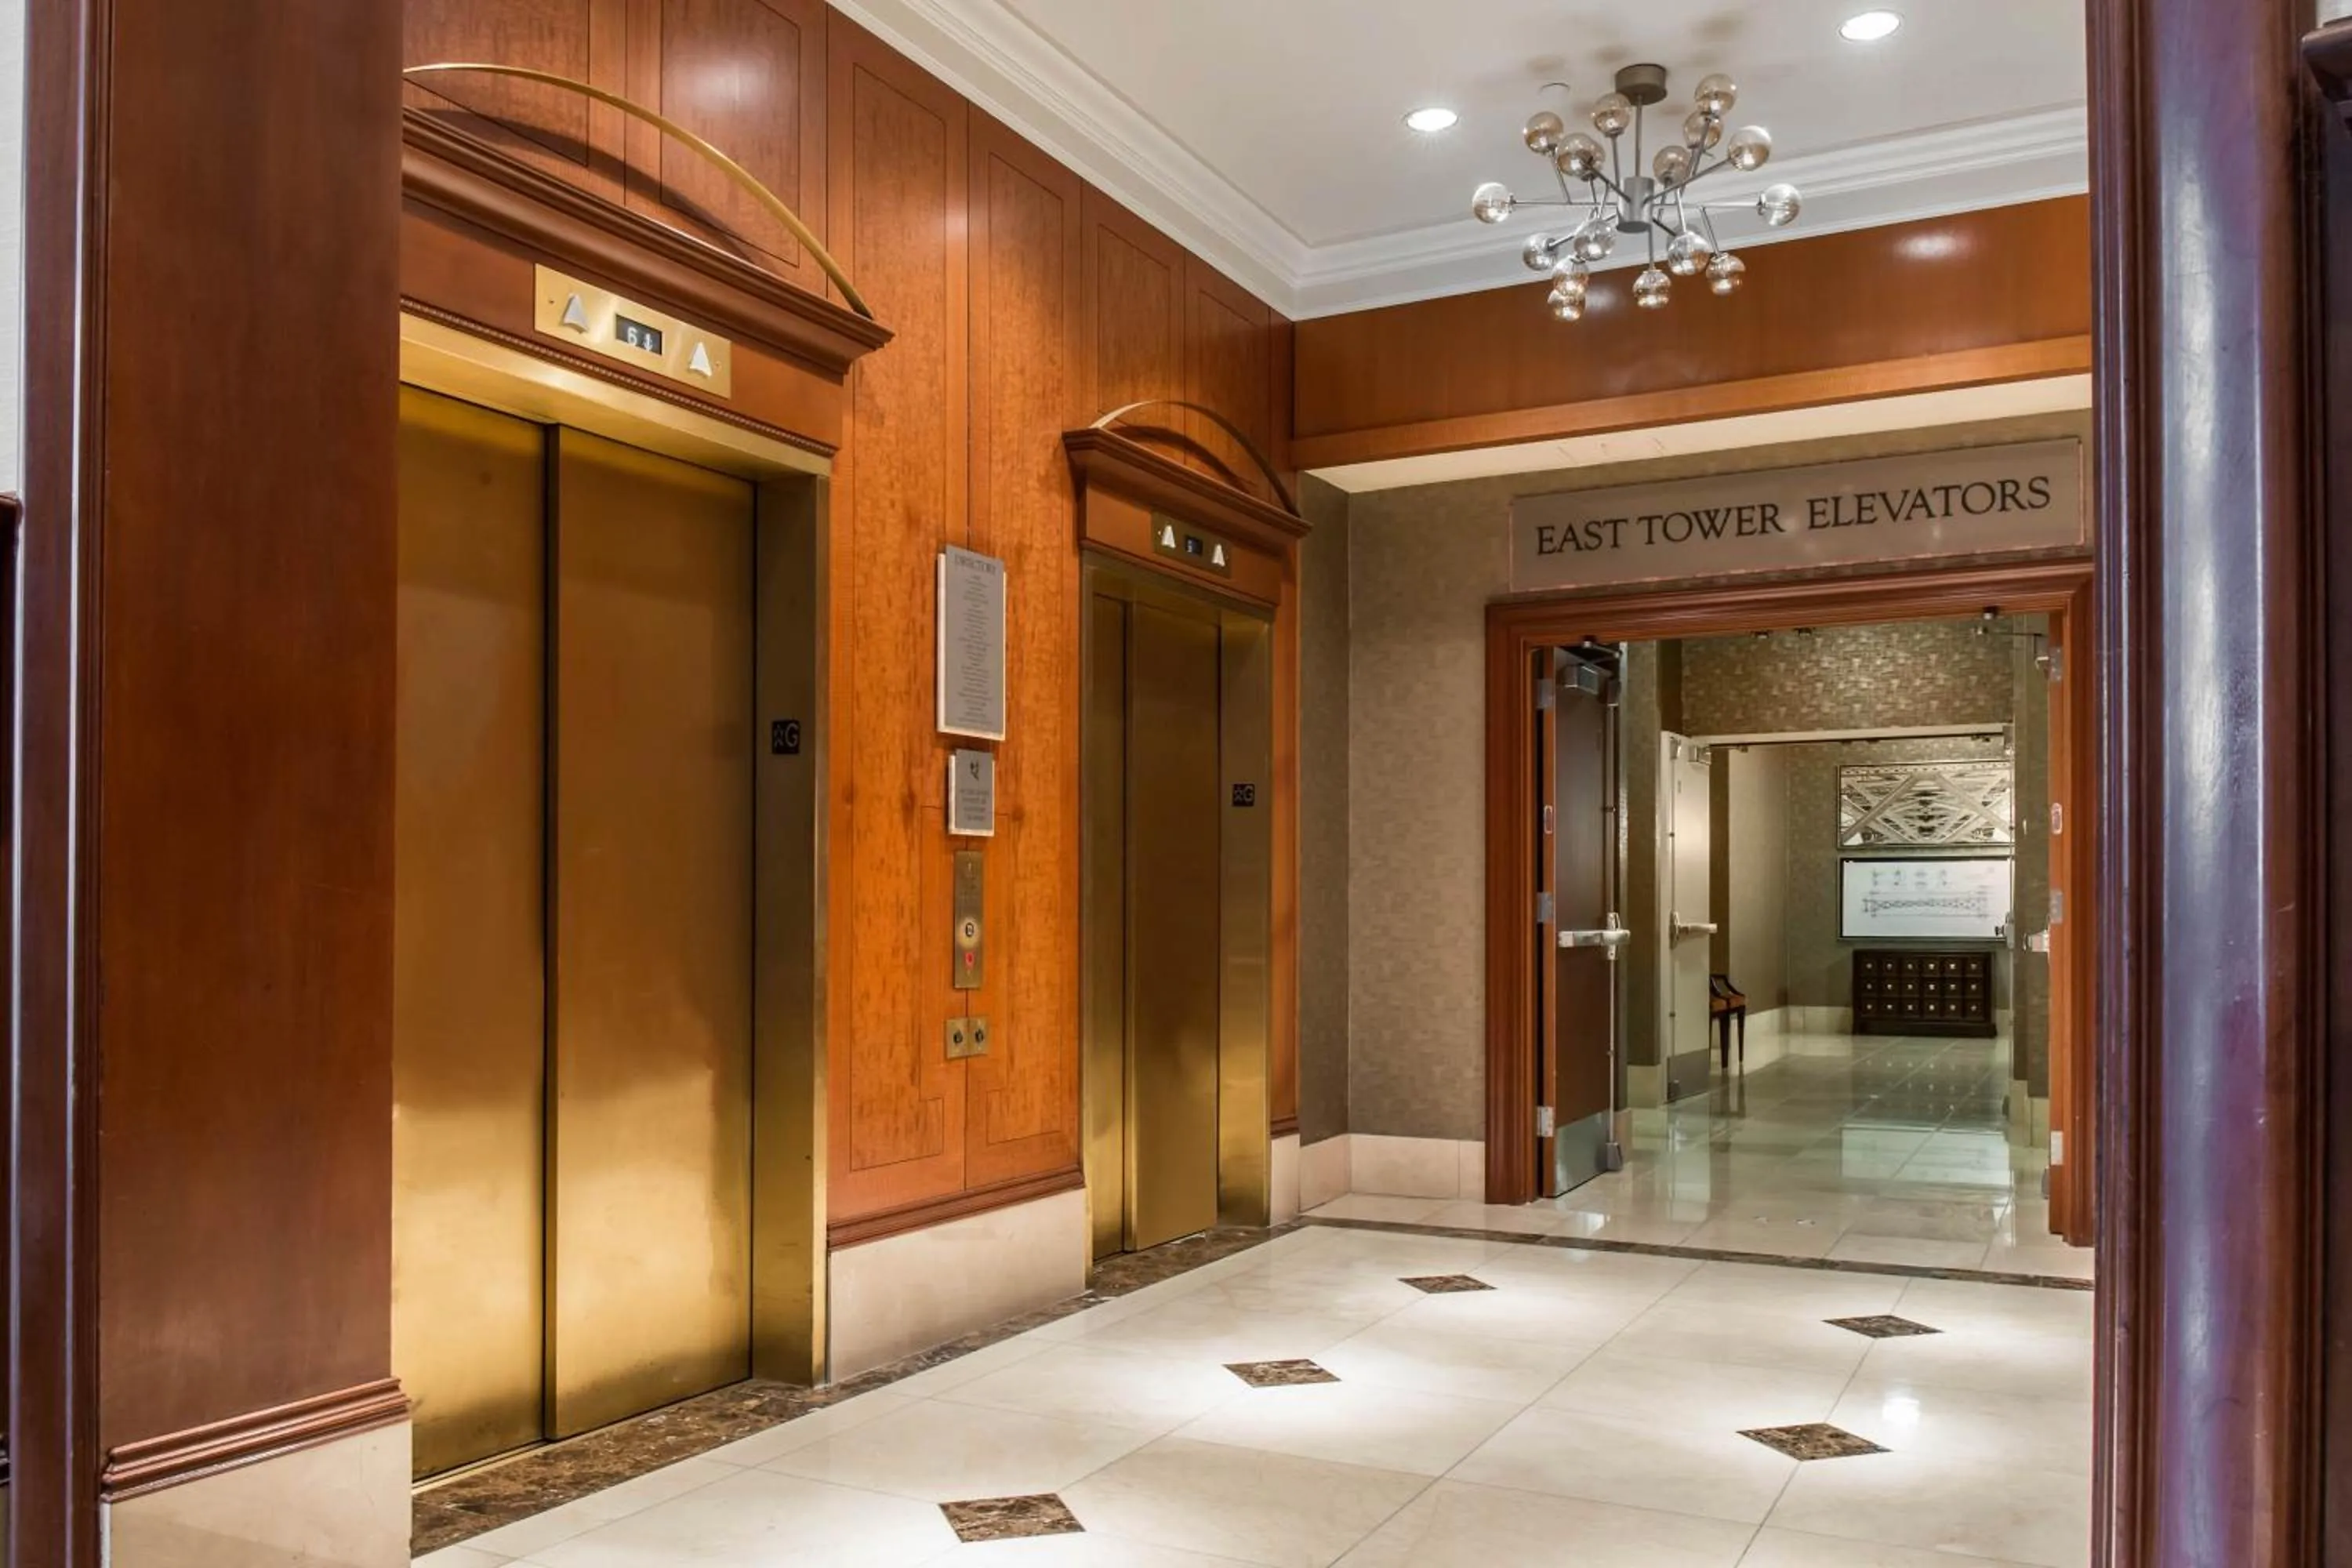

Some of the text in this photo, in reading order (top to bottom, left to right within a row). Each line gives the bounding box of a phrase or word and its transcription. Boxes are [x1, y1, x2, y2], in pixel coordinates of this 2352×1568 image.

[1536, 475, 2051, 556] EAST TOWER ELEVATORS
